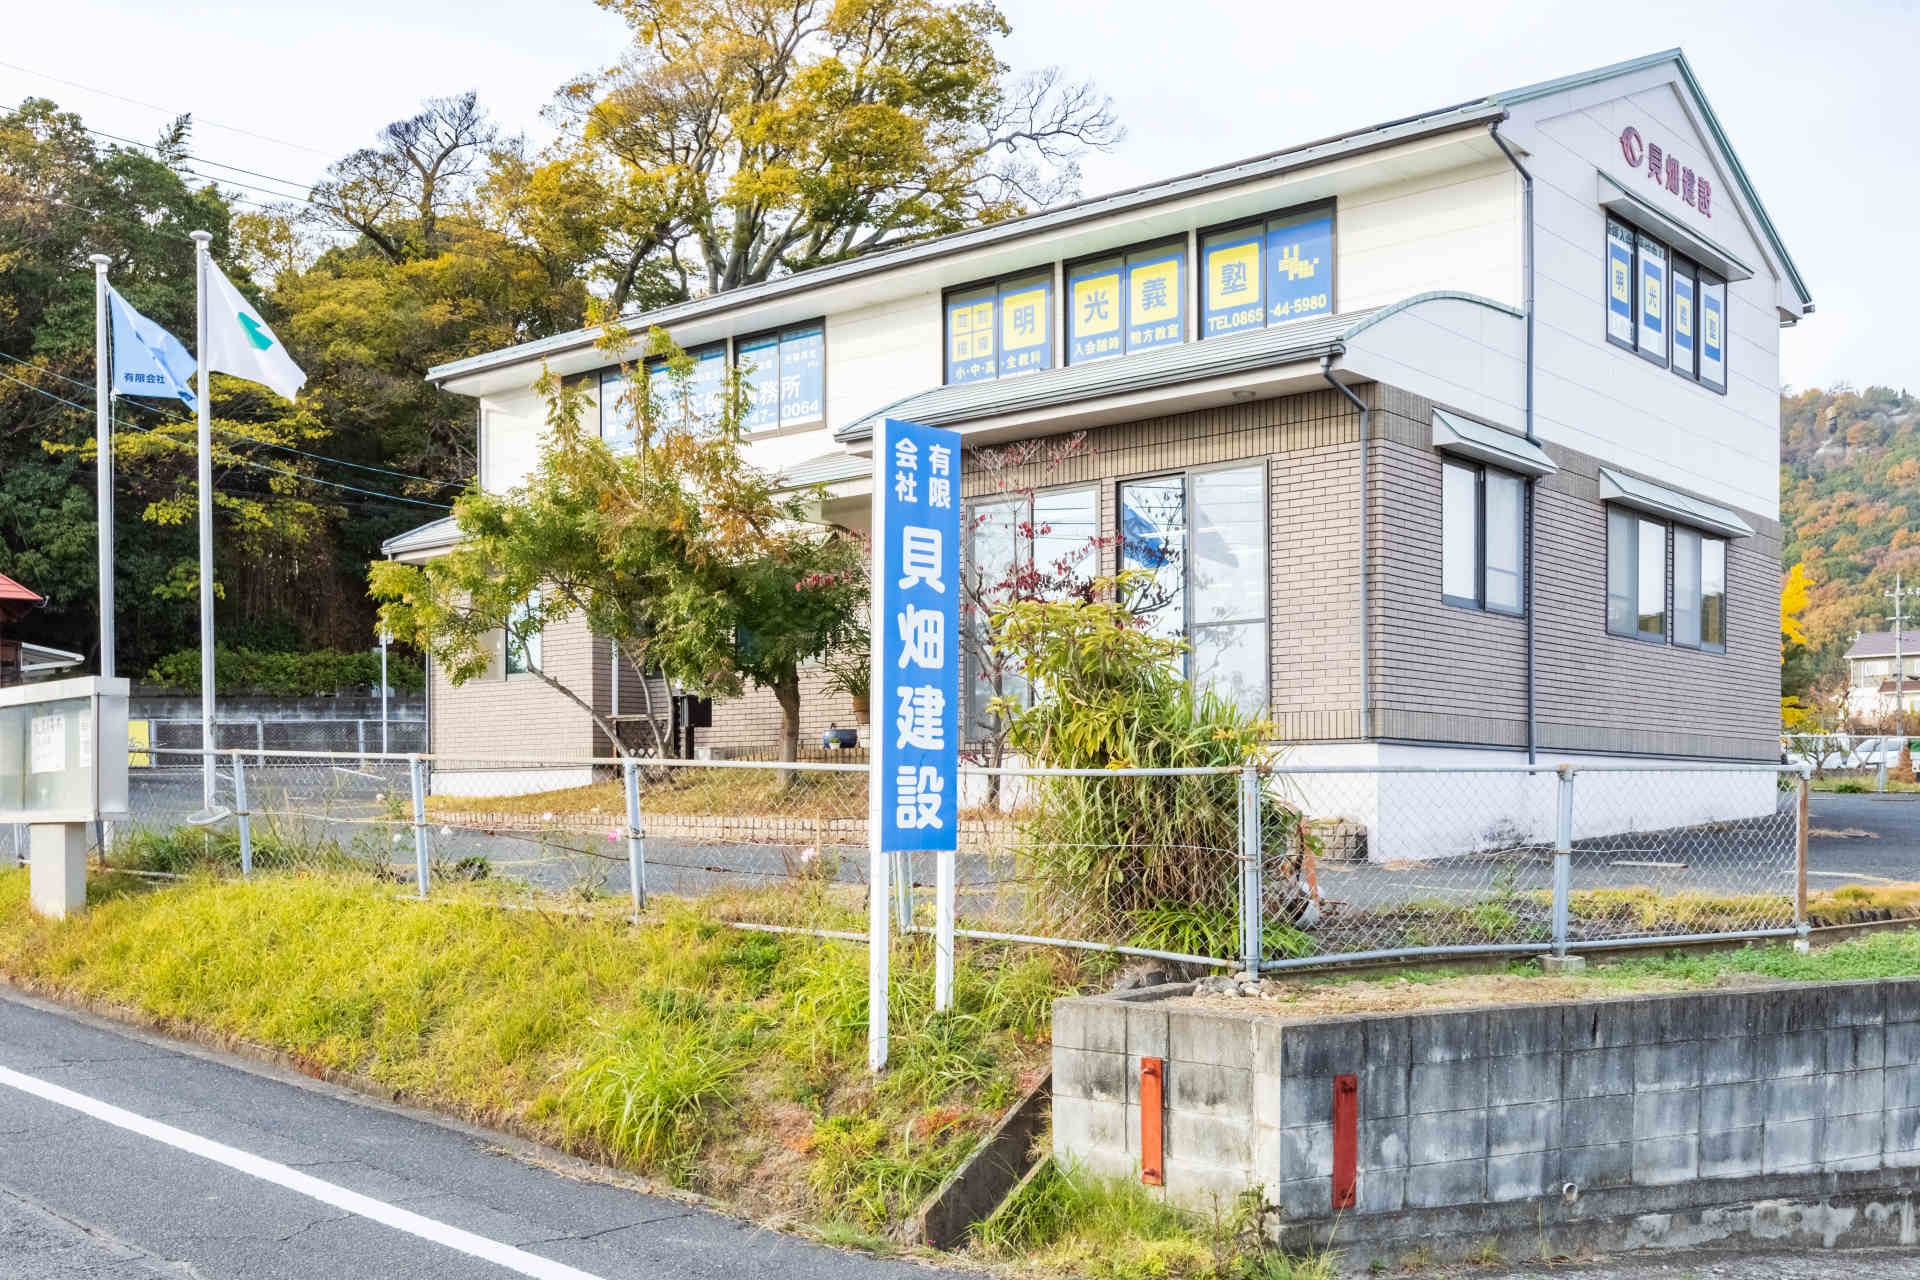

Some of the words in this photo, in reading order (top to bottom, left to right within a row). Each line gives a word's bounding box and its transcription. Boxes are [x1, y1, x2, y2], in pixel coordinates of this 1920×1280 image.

[1647, 142, 1712, 219] 貝畑建設
[1012, 260, 1249, 336] 明光義塾
[123, 371, 166, 385] 有限会社
[894, 437, 919, 504] 会社
[928, 443, 952, 510] 有限
[896, 525, 946, 831] 貝畑建設
